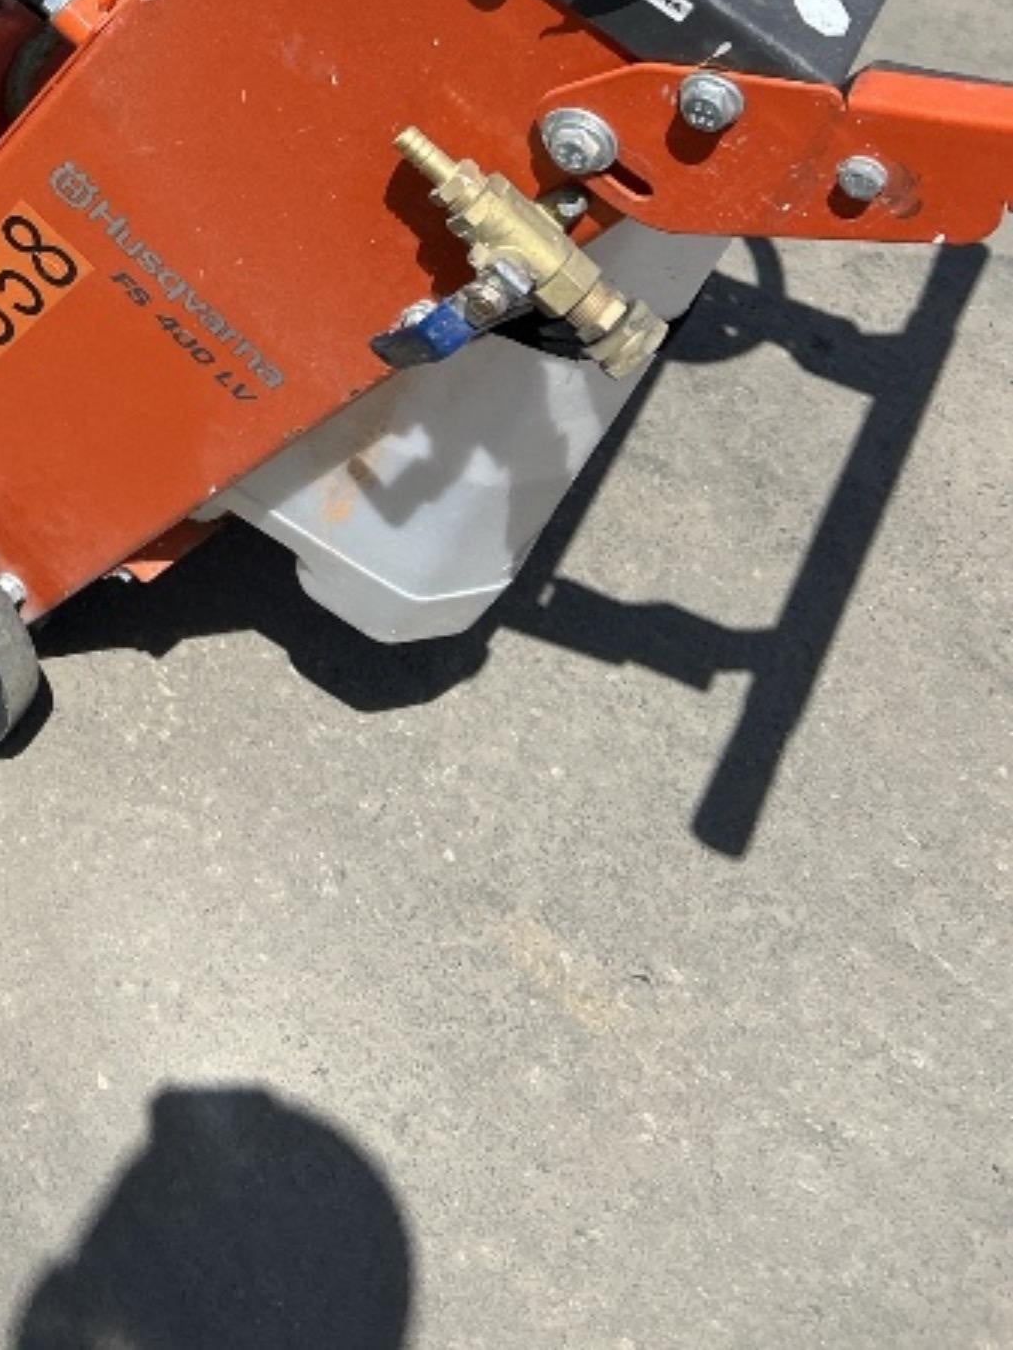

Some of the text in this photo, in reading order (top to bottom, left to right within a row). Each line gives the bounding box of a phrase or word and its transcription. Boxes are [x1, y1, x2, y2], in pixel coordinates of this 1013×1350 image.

[89, 200, 285, 390] Husqvarna
[109, 272, 258, 401] FS 400 LV
